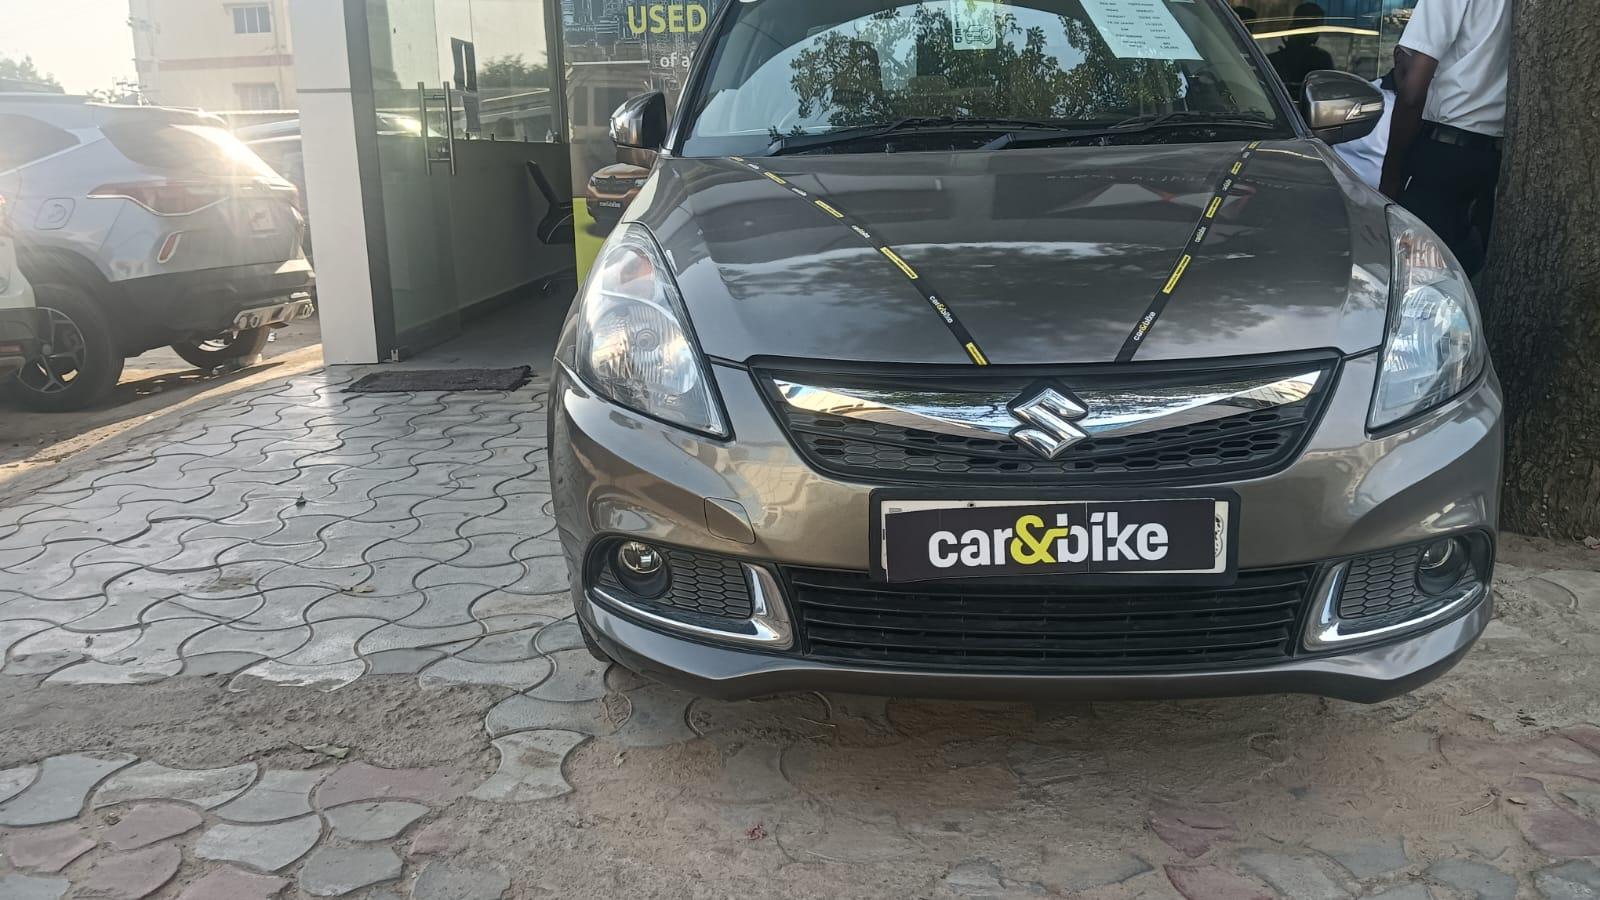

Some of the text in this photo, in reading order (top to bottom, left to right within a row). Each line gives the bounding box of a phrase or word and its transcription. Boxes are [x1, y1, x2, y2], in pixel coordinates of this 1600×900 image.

[627, 5, 707, 34] USED
[660, 52, 677, 68] of
[1133, 311, 1156, 341] car&bike
[928, 511, 1169, 568] car&bike
